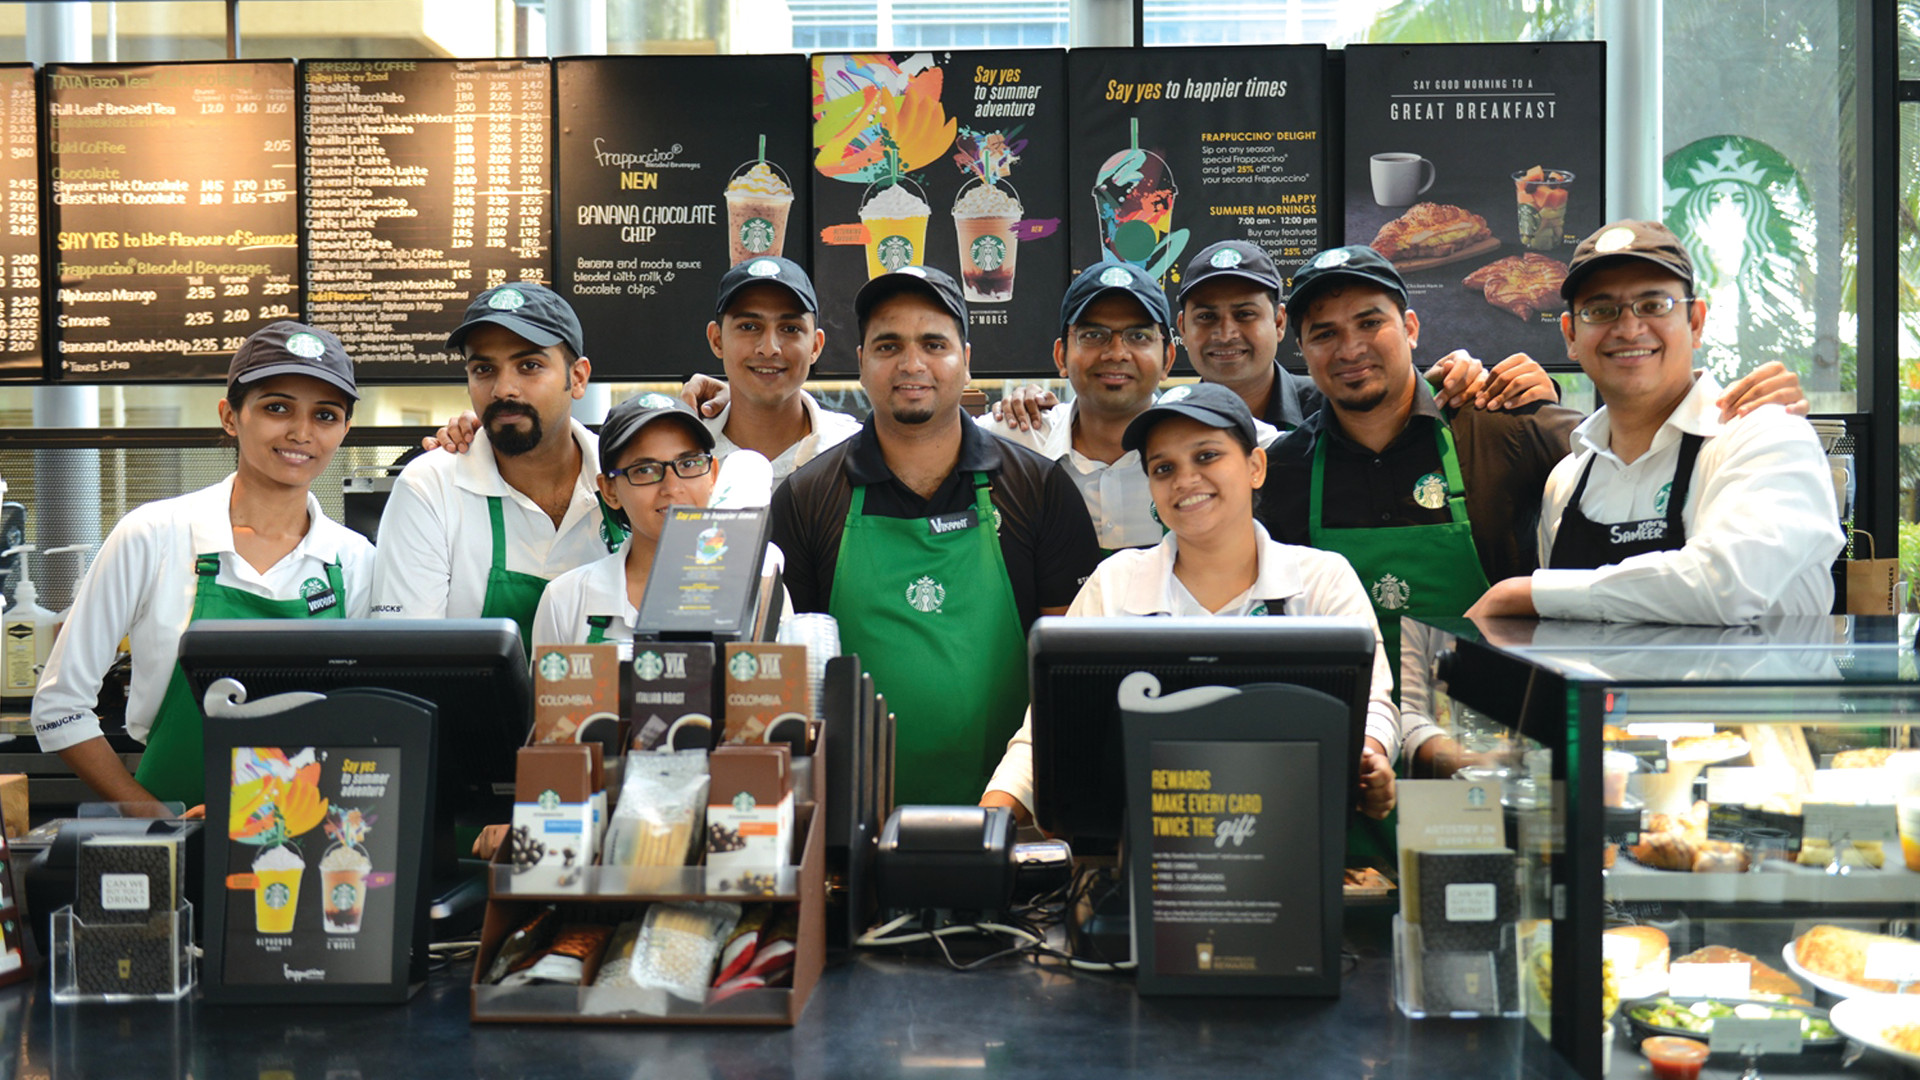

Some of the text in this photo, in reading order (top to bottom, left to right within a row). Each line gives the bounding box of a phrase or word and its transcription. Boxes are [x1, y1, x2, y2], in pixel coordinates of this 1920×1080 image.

[974, 65, 1021, 85] Say yes
[1105, 76, 1287, 104] Say yes to happier times
[1413, 79, 1533, 90] SAY GOOD MORNING TO A
[974, 85, 1041, 100] to summer
[974, 100, 1035, 117] adventure
[1390, 101, 1556, 120] GREAT BREAKFAST
[1277, 132, 1316, 140] DELIGHT
[264, 140, 291, 151] 205
[353, 146, 386, 155] Latte
[1202, 146, 1214, 154] Sip
[1202, 156, 1232, 164] special
[52, 167, 119, 179] Chocolate
[1202, 166, 1219, 174] and
[1221, 166, 1235, 175] get
[9, 179, 37, 189] 245
[621, 172, 658, 189] NEW
[1222, 175, 1252, 183] second
[1282, 194, 1316, 204] HAPPY
[577, 205, 716, 225] BANANA CHOCOLATE
[1210, 205, 1316, 215] SUMMER MORNINGS
[622, 226, 656, 242] CHIP
[1264, 229, 1280, 237] any
[1282, 228, 1317, 236] featured
[58, 233, 88, 249] SAY
[90, 233, 118, 248] YES
[169, 232, 225, 246] flavour
[1260, 238, 1298, 246] breakfast
[1284, 248, 1300, 256] 25%
[11, 254, 39, 265] 200
[578, 257, 701, 269] Banana and mocha sauce
[137, 260, 193, 275] Blended
[195, 262, 272, 277] Beverages
[573, 271, 610, 282] blended
[613, 272, 636, 282] with
[639, 271, 663, 285] milk
[113, 289, 157, 305] Mango
[186, 287, 215, 299] 235
[224, 285, 249, 296] 260
[573, 284, 621, 294] Chocolate
[185, 305, 288, 326] 235 260 290
[569, 654, 594, 679] VIA
[664, 653, 687, 678] VIA
[758, 653, 782, 679] VIA
[539, 694, 593, 706] COLOMBIA
[728, 694, 782, 706] COLOMBIA
[1152, 769, 1212, 790] REWARDS
[1152, 793, 1262, 815] MAKE EVERY CARD
[1152, 814, 1257, 848] TWICE THE gift
